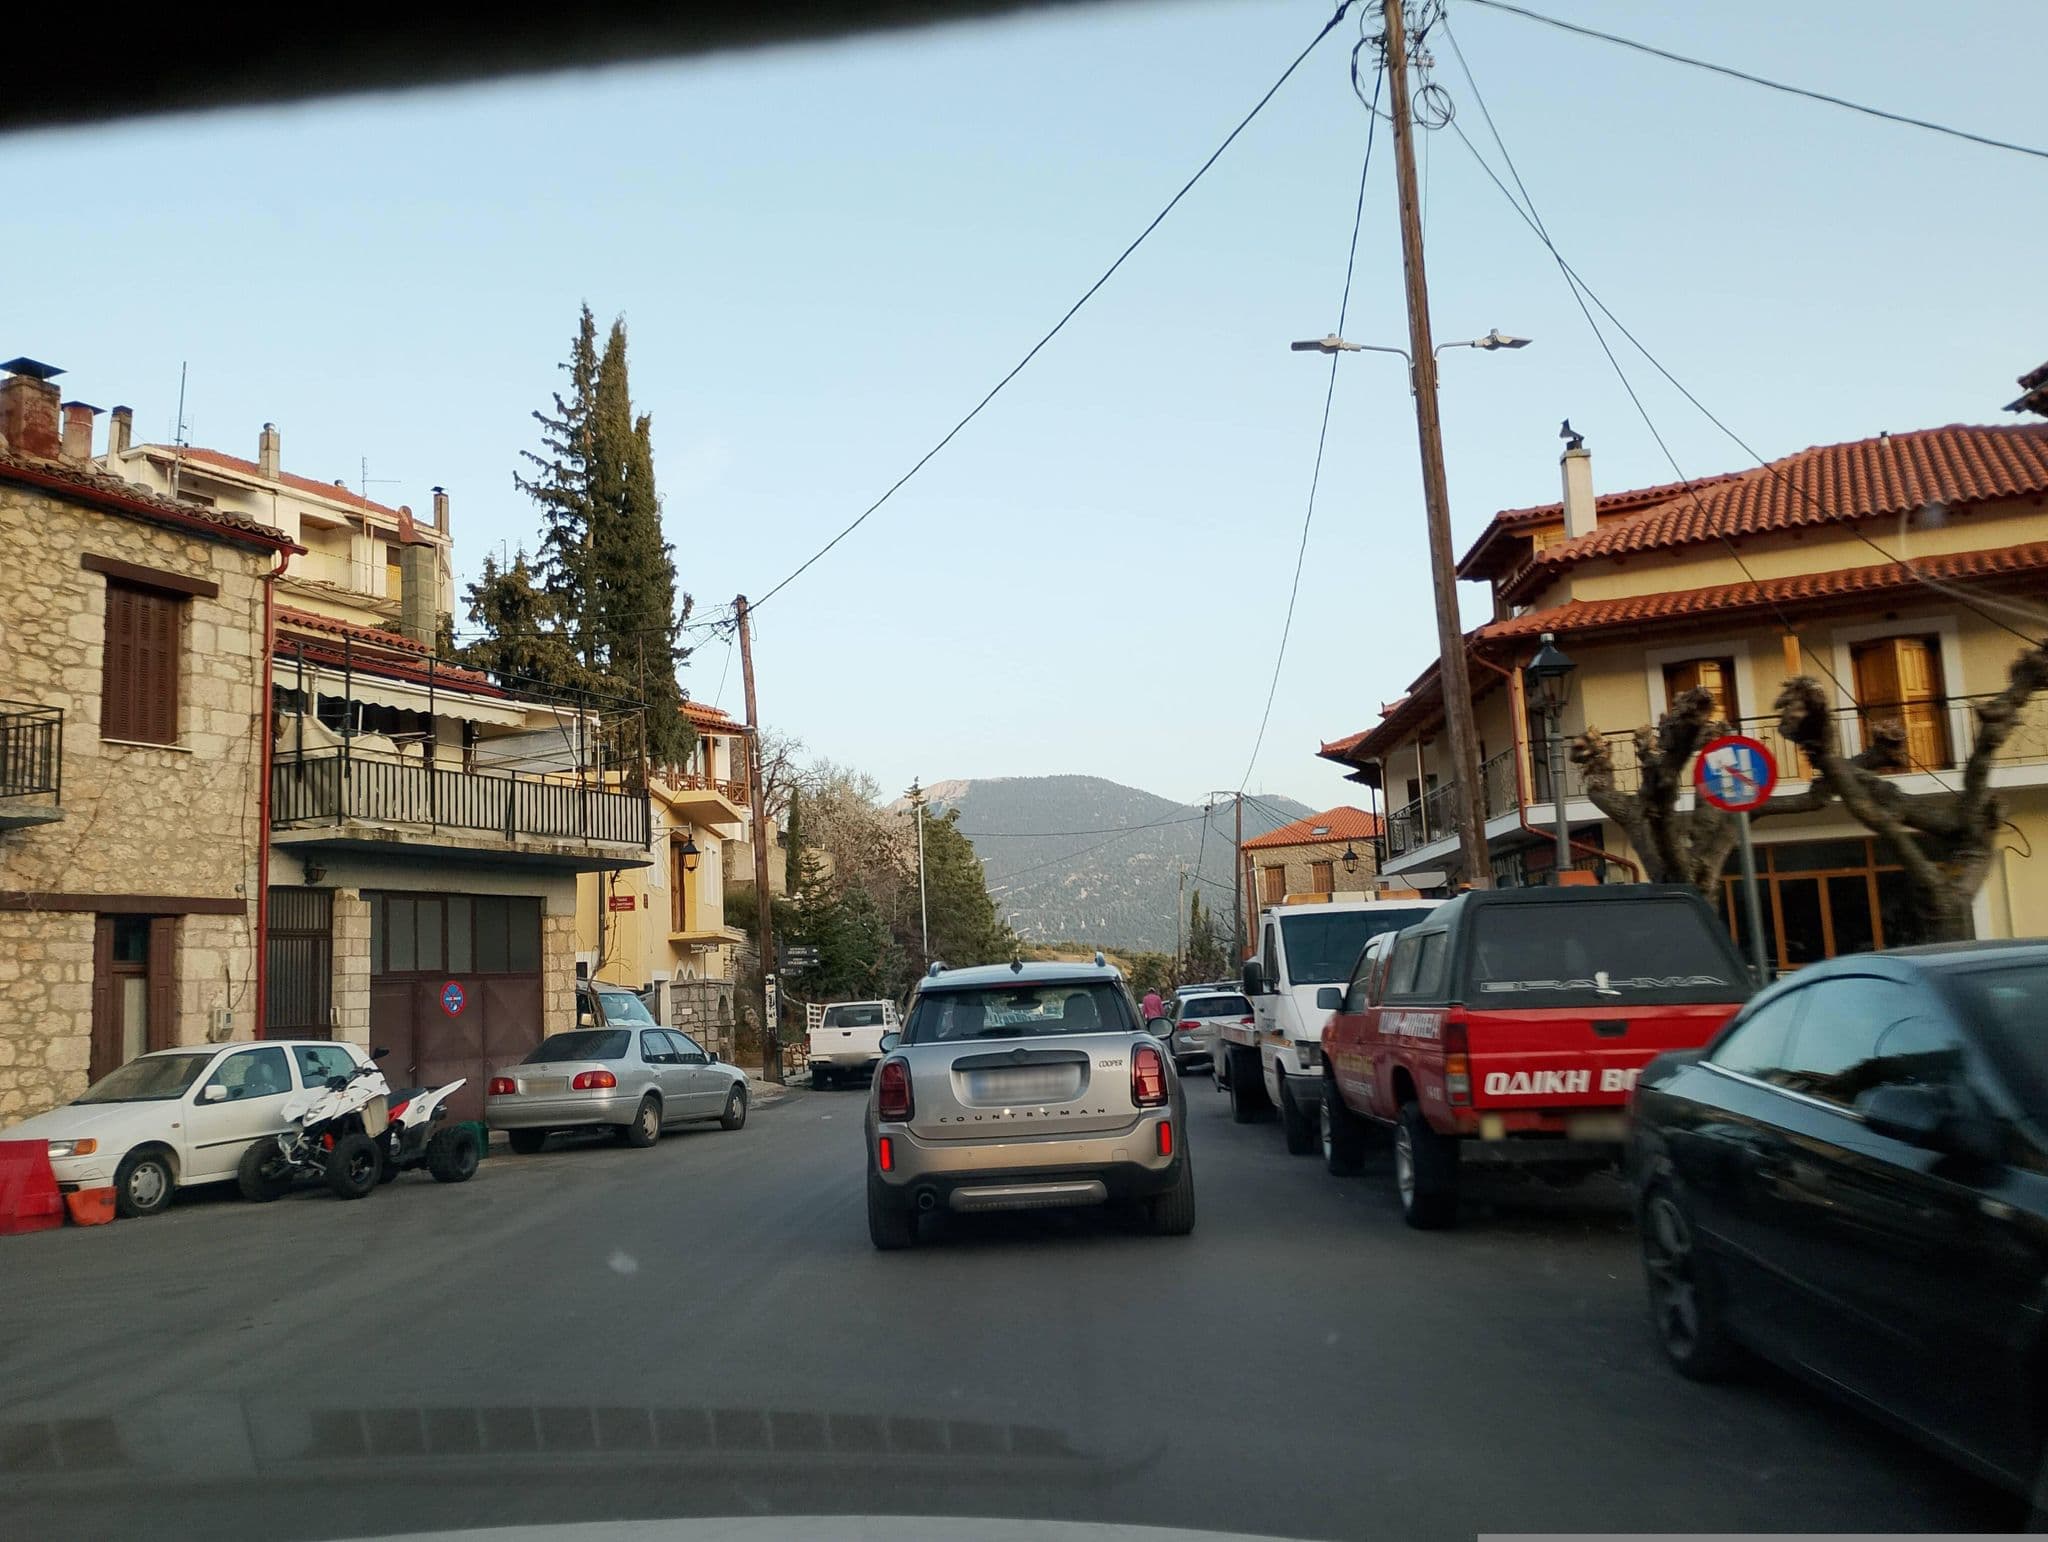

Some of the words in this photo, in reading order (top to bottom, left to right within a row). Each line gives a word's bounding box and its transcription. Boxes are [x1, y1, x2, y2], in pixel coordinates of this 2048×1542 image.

[1098, 1059, 1124, 1068] COOPER
[1484, 1069, 1592, 1095] ΟΔΙΚΗ
[939, 1108, 1106, 1123] COUNTRYMAN
